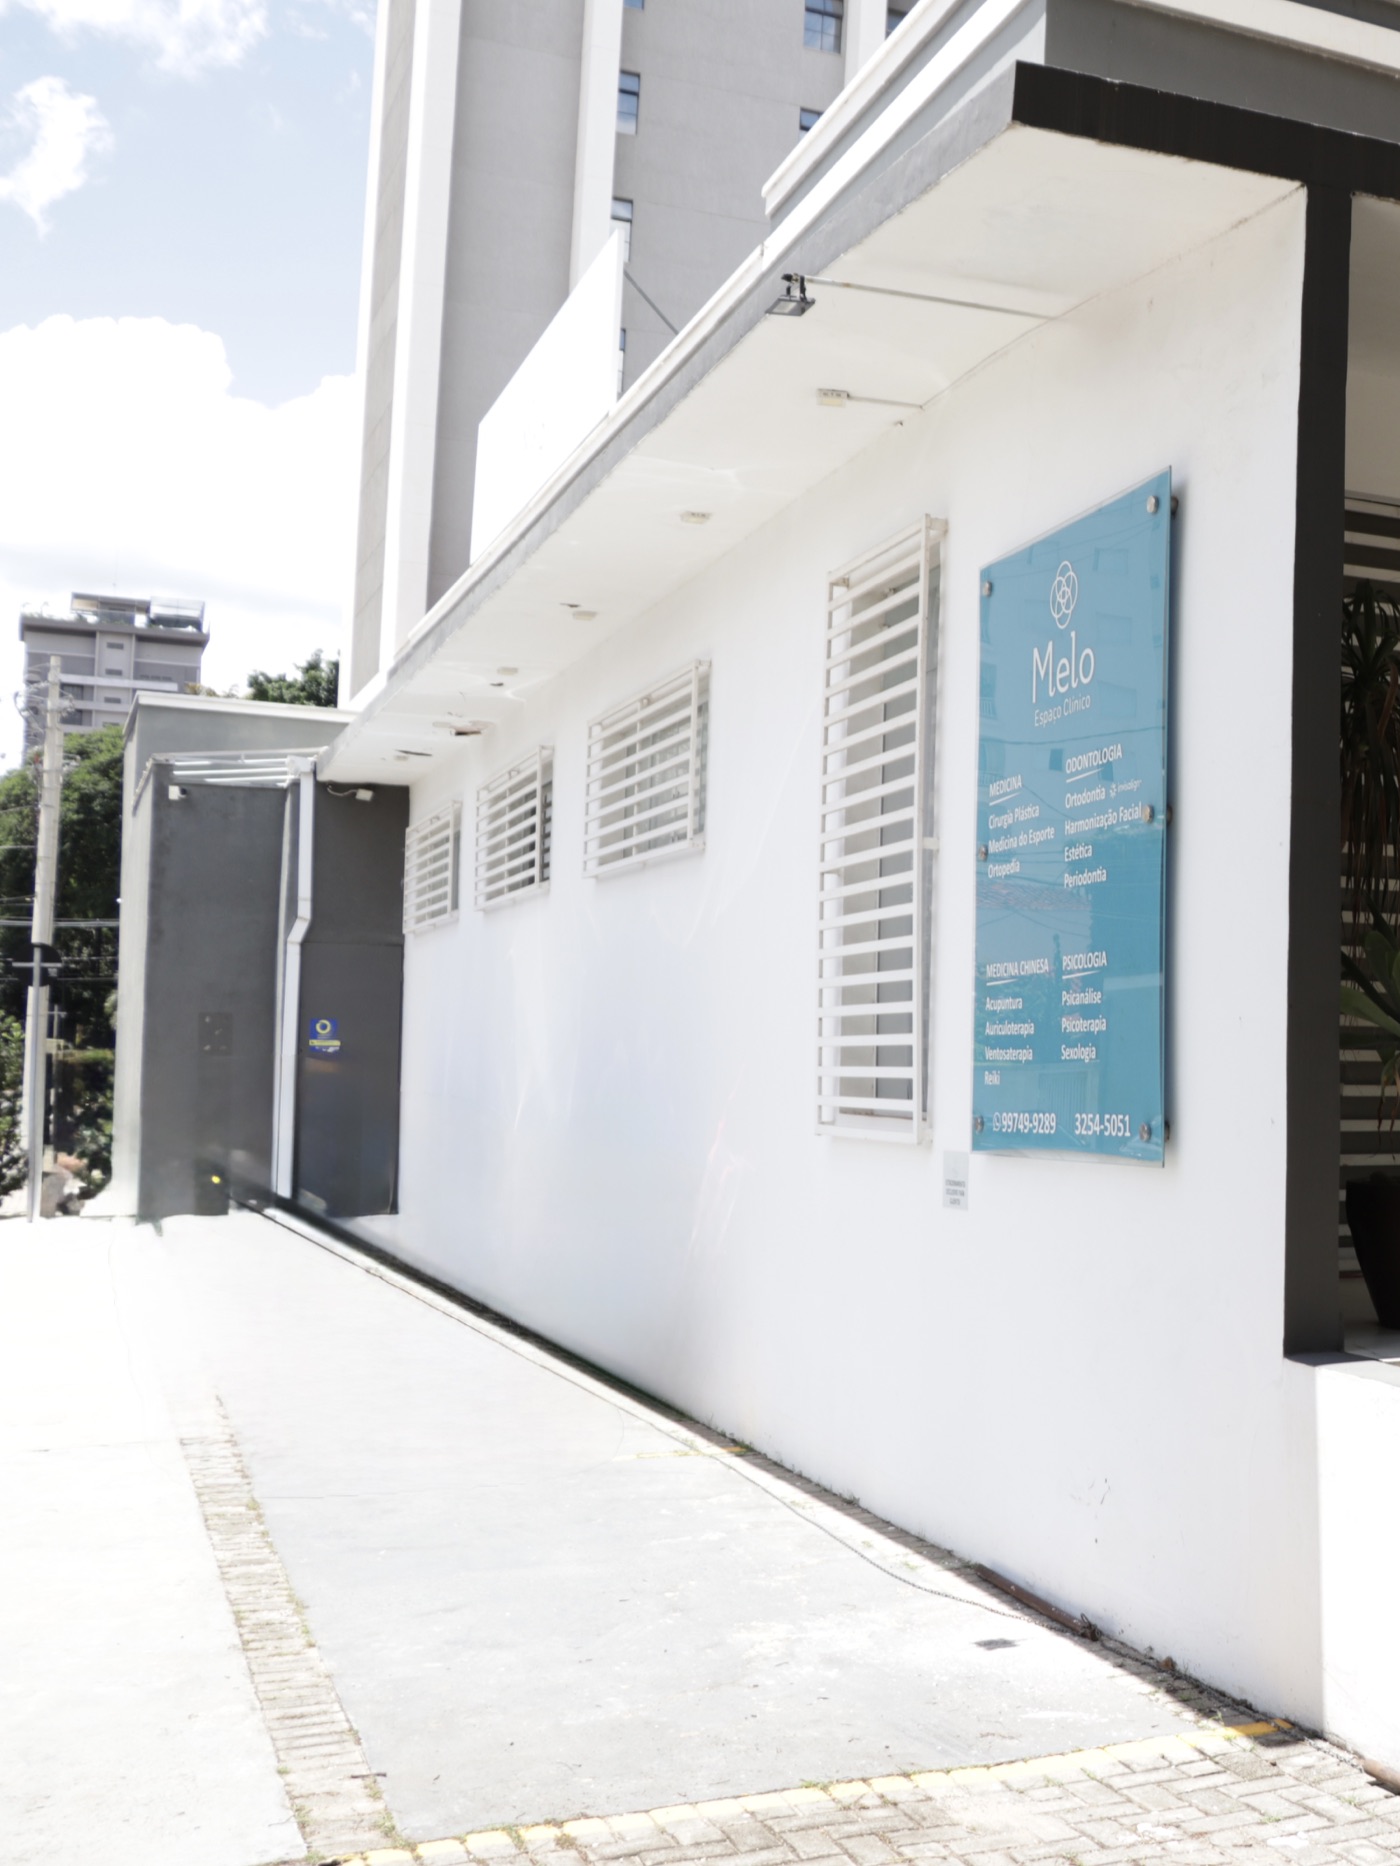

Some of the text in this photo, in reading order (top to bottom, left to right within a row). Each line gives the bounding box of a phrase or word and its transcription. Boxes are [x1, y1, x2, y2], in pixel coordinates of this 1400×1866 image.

[1032, 630, 1094, 703] Melo
[1034, 694, 1091, 728] Espaço Clínico
[1065, 743, 1122, 774] ODONTOLOGIA
[989, 774, 1022, 798] MEDICINA
[1065, 784, 1106, 809] Ortodontia
[988, 803, 1040, 830] Cirurgia Plástica
[1064, 801, 1142, 836] Harmonização Facial
[988, 826, 1055, 854] Medicina do Esporte
[1064, 842, 1093, 863] Estética
[987, 858, 1021, 879] Ortopedia
[1064, 865, 1107, 889] Periodontia
[986, 958, 1049, 978] MEDICINA CHINESA
[1062, 951, 1108, 971] PSICOLOGIA
[985, 996, 1023, 1013] Acupuntura
[1061, 987, 1102, 1006] Psicanálise
[985, 1019, 1035, 1038] Auriculoterapia
[1061, 1014, 1107, 1035] Psicoterapia
[984, 1045, 1034, 1063] Ventosaterapia
[1061, 1043, 1097, 1063] Sexologia
[984, 1071, 1001, 1085] Reiki
[1001, 1112, 1057, 1134] 99749-9289
[1074, 1113, 1132, 1137] 3254-5051
